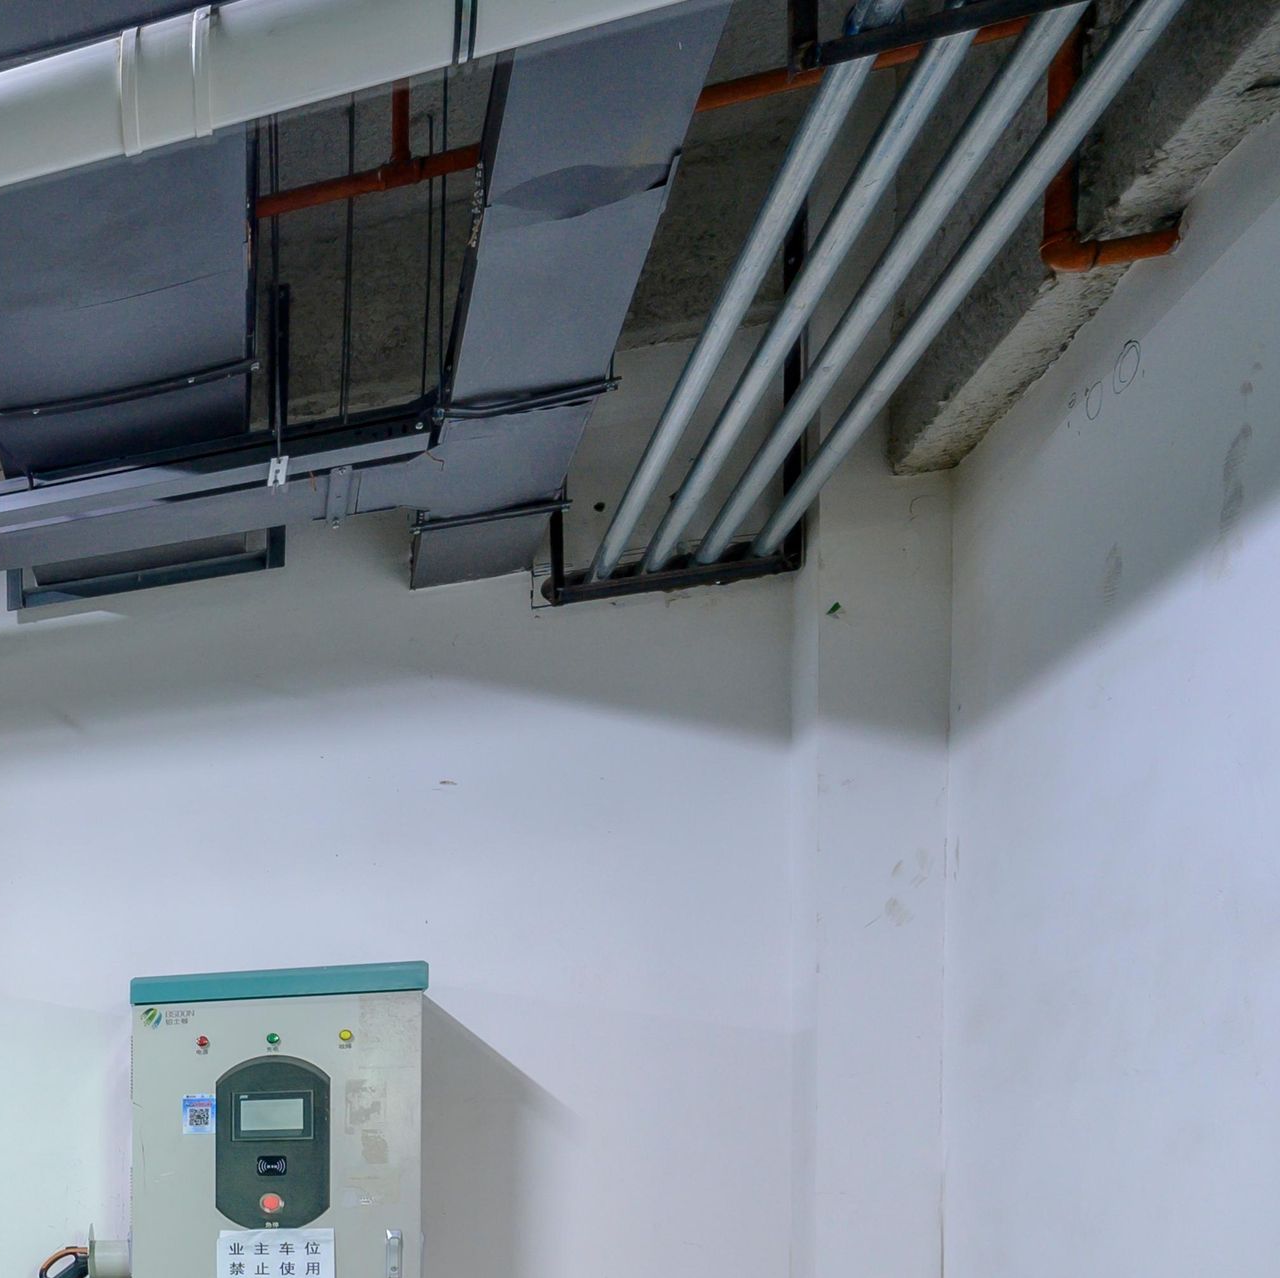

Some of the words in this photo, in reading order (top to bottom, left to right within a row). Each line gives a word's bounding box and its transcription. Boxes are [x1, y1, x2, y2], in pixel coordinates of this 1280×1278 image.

[265, 1221, 280, 1229] 急停
[228, 1241, 321, 1256] 业主车位
[228, 1261, 321, 1276] 禁止使用
